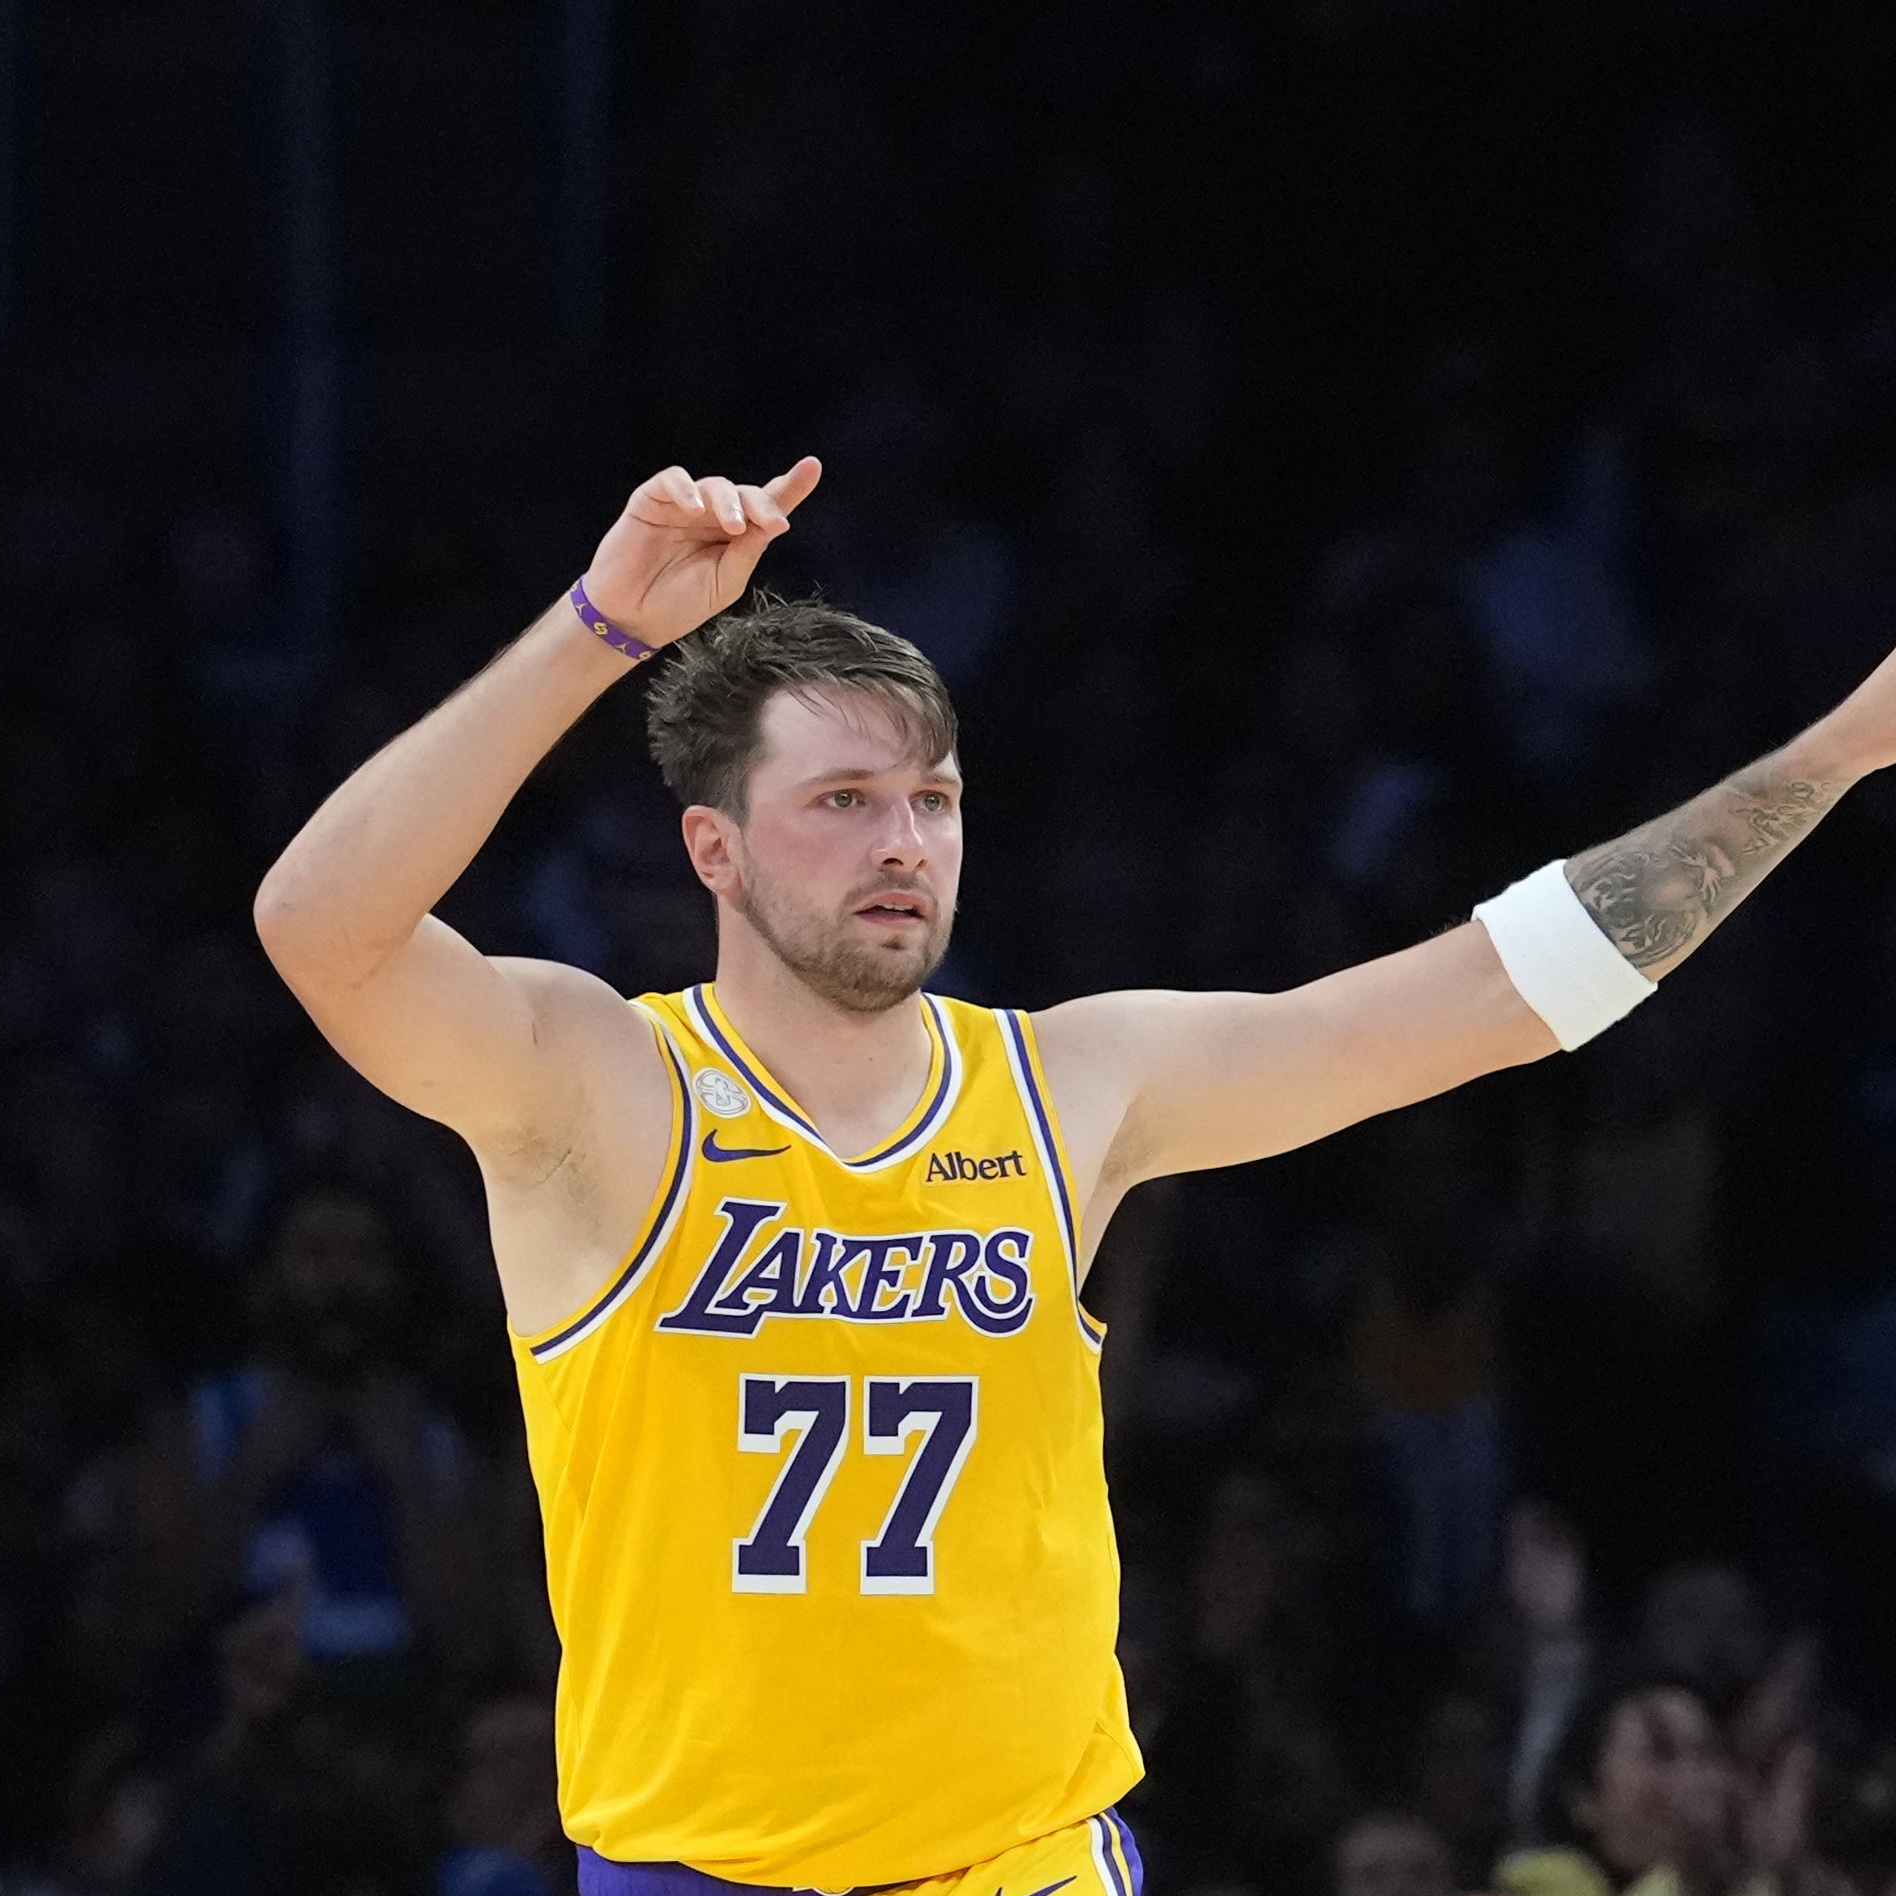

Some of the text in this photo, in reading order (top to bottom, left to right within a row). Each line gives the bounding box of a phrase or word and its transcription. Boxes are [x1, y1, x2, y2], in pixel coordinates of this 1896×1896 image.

[926, 1150, 1027, 1182] Albert
[655, 1199, 1034, 1339] LAKERS
[732, 1374, 979, 1596] 77
